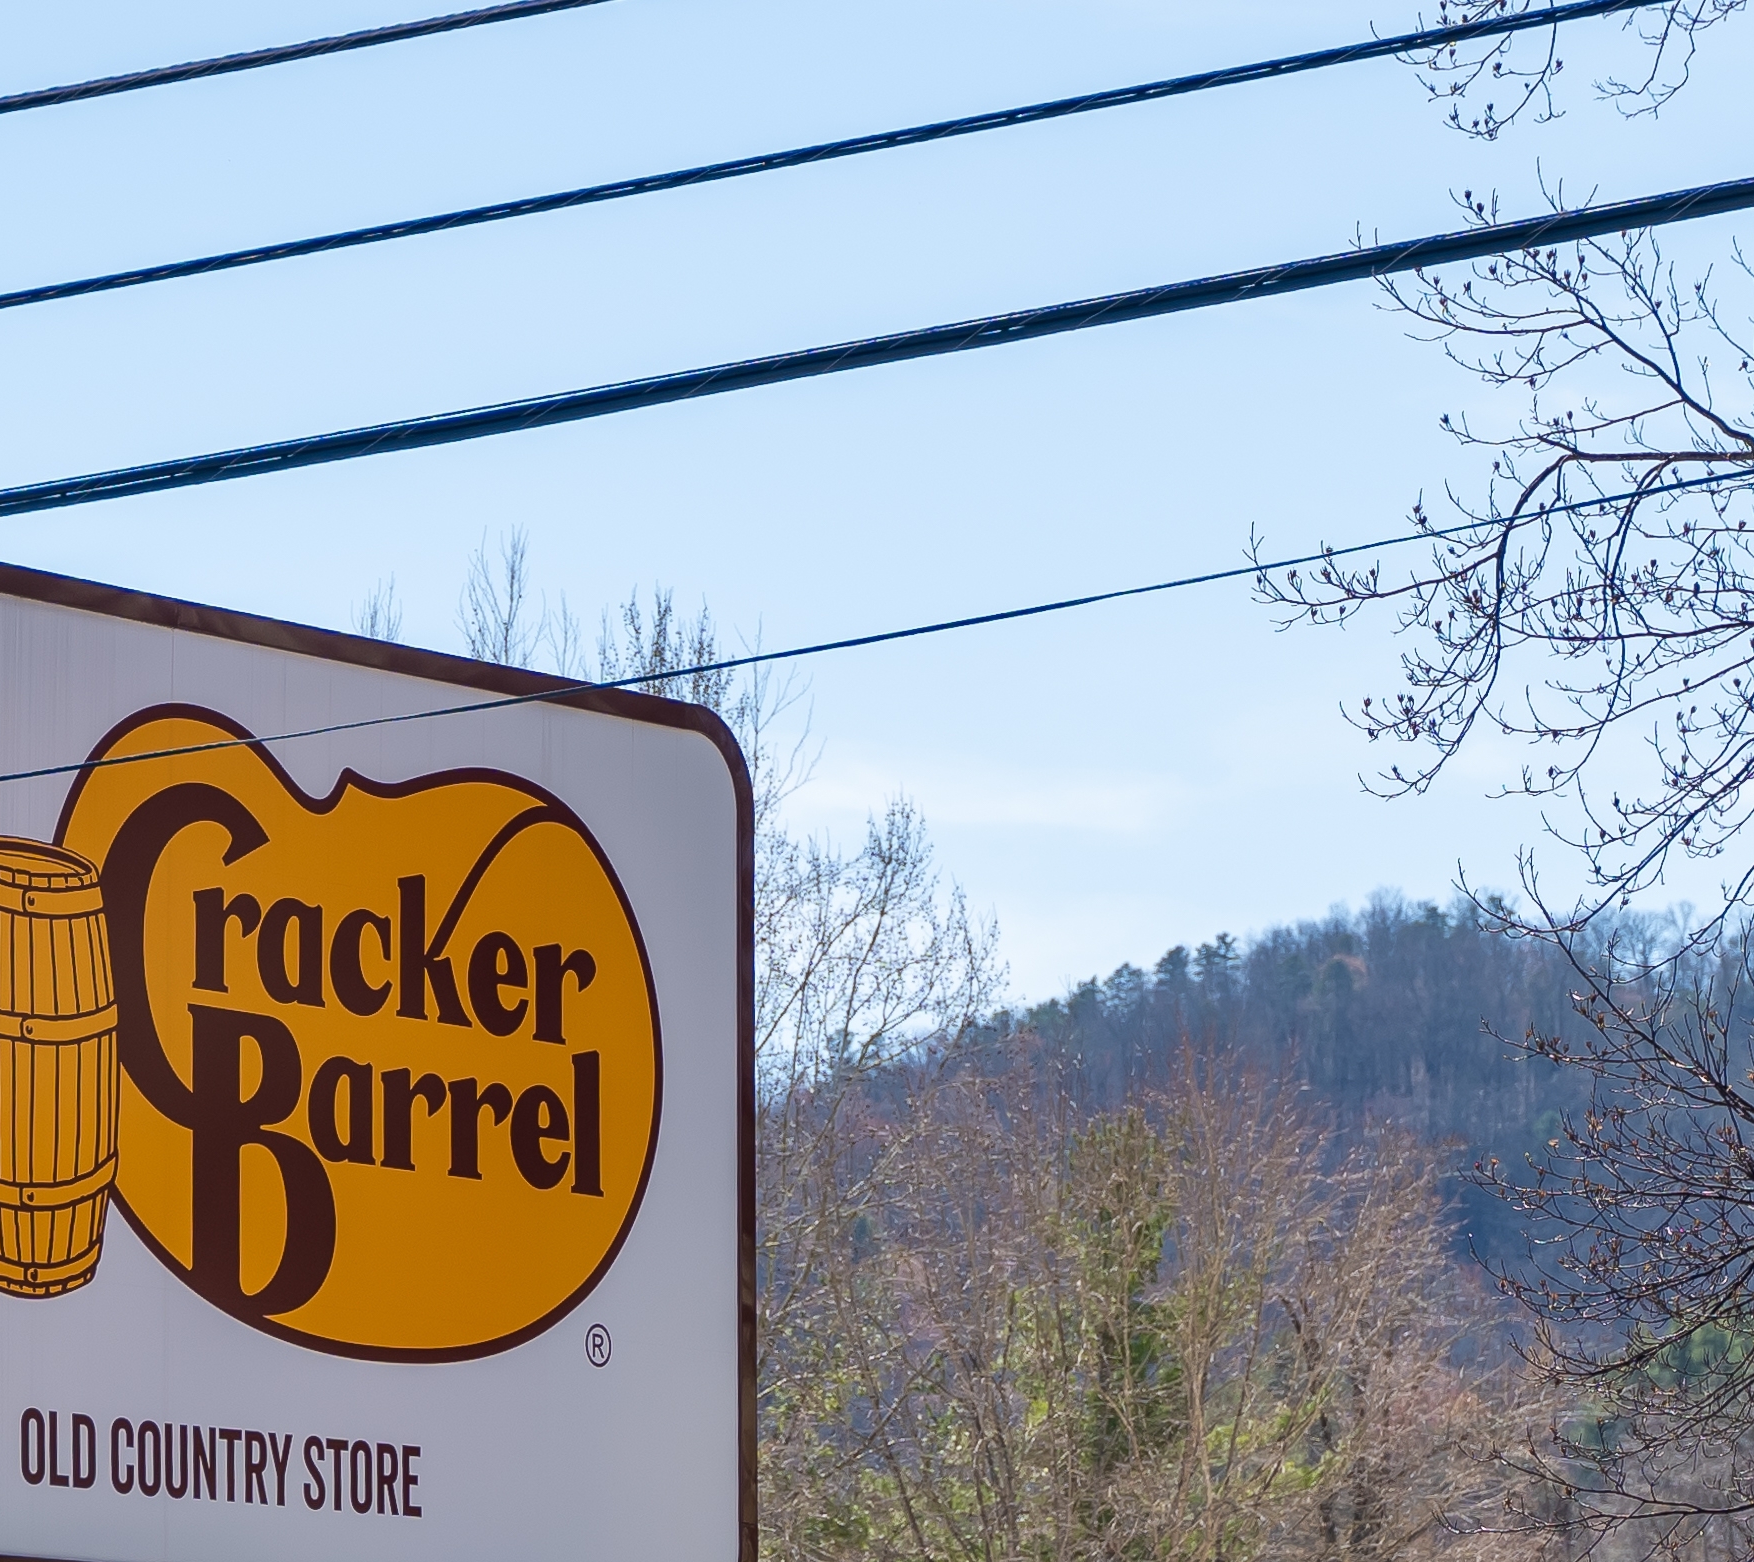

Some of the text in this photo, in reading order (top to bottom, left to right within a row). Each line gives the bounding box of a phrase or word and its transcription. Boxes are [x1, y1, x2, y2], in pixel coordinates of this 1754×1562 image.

[105, 780, 597, 1130] Cracker
[186, 1003, 606, 1318] Barrel
[18, 1405, 423, 1520] OLD COUNTRY STORE
